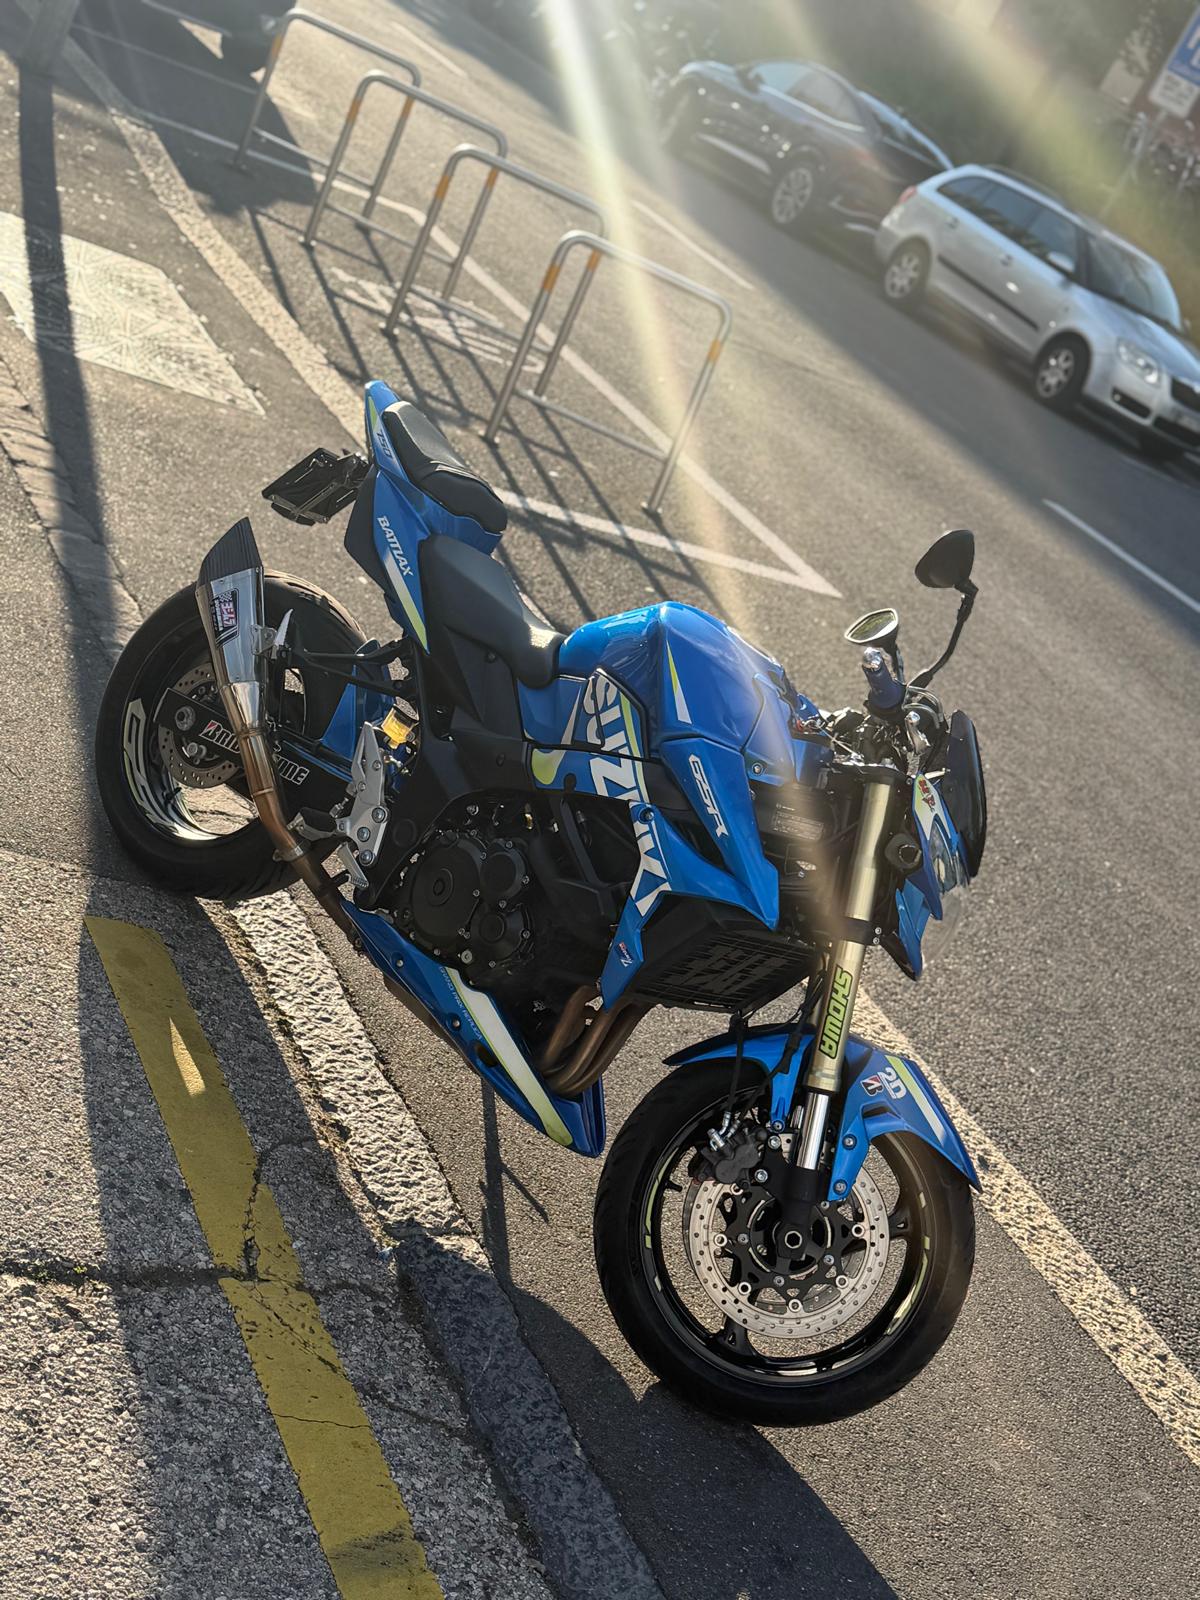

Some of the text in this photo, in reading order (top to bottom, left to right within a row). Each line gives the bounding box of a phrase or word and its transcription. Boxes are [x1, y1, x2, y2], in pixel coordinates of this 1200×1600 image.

[377, 515, 413, 577] BATTLAX
[199, 720, 310, 785] BRIDONE
[689, 754, 728, 838] GSR
[819, 964, 853, 1060] SHOWA
